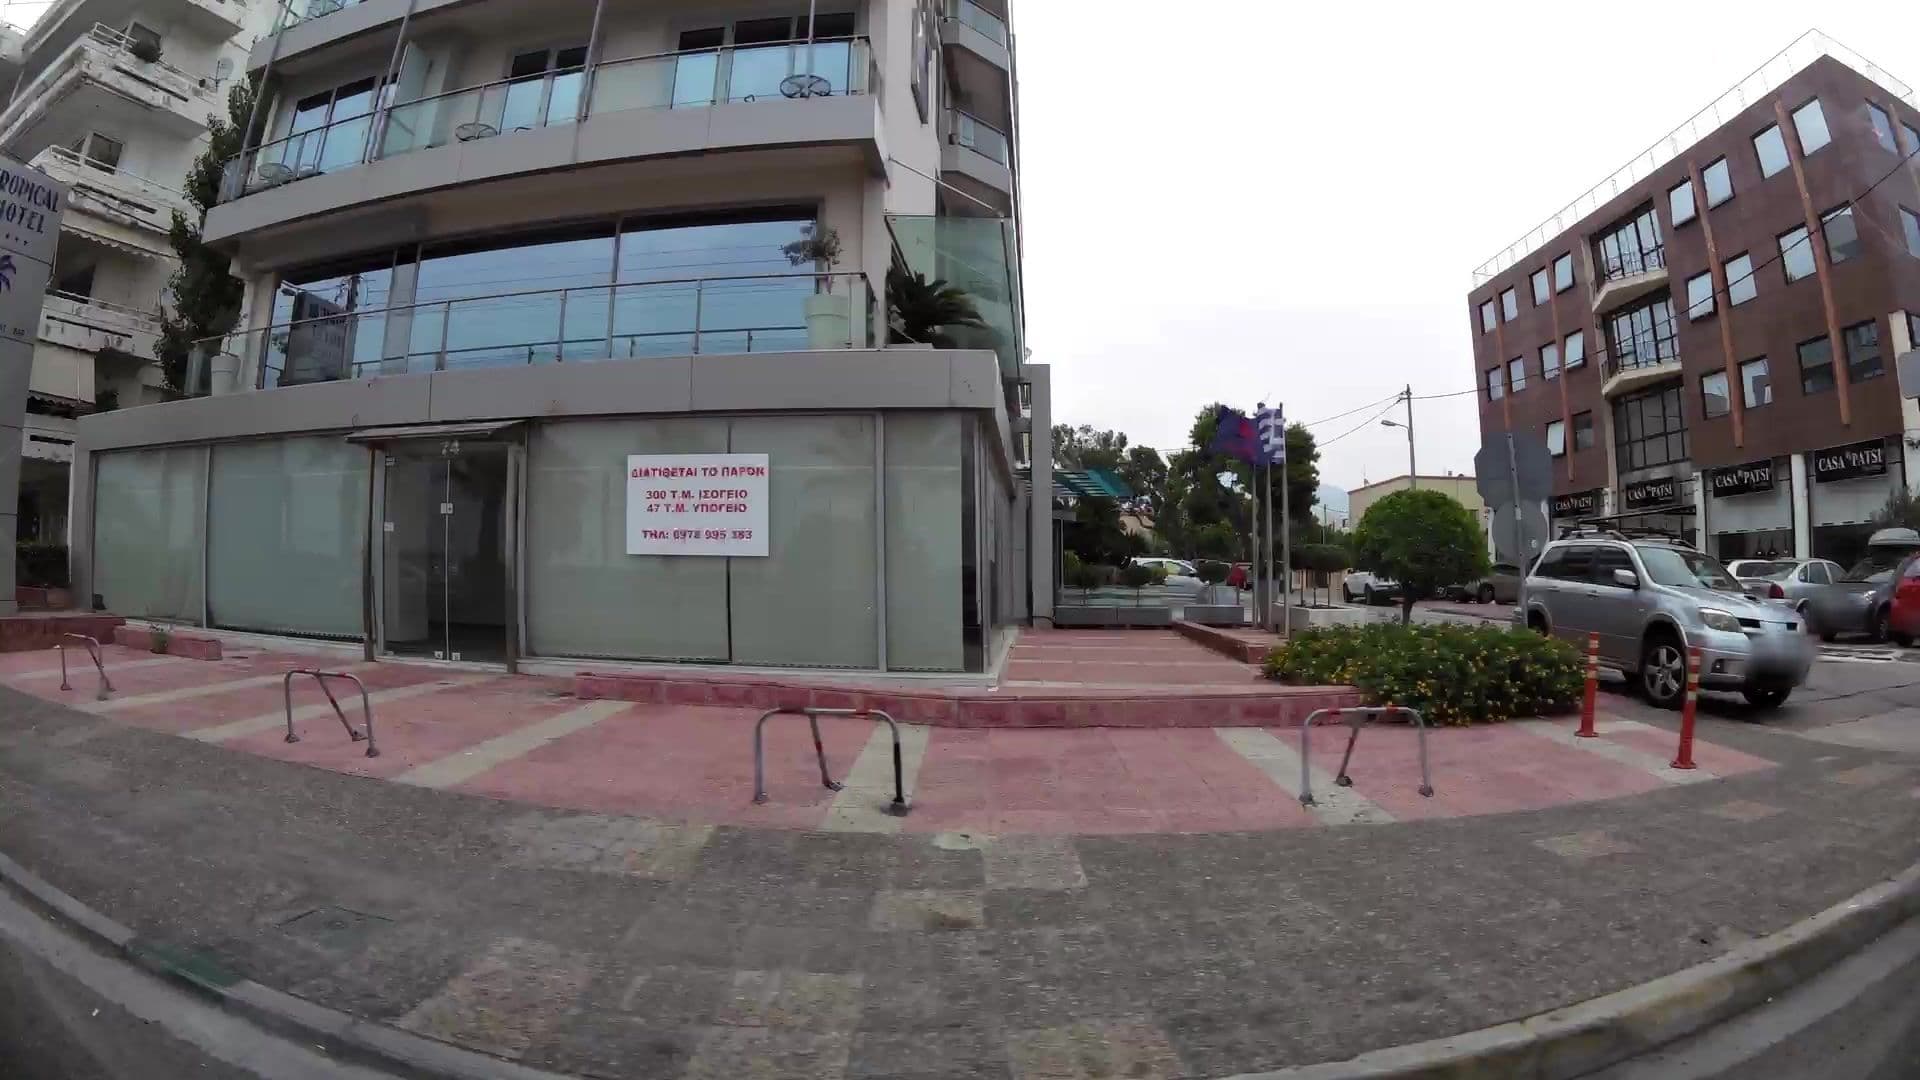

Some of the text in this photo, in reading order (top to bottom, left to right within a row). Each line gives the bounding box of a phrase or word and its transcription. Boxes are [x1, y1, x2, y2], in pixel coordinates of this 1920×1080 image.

[0, 169, 58, 213] ROPICAL
[1818, 455, 1846, 472] CASA
[1851, 448, 1883, 467] PATSI
[632, 466, 765, 478] ΔΙΑΤΙΘΕΤΑΙ ΤΟ ΠΑΡΟΝ
[1743, 467, 1769, 484] PATSI
[646, 490, 667, 499] 300
[699, 489, 748, 500] ΙΣΟΓΕΙΟ
[646, 504, 660, 512] 47
[693, 503, 747, 513] ΥΠΟΓΕΙΟ
